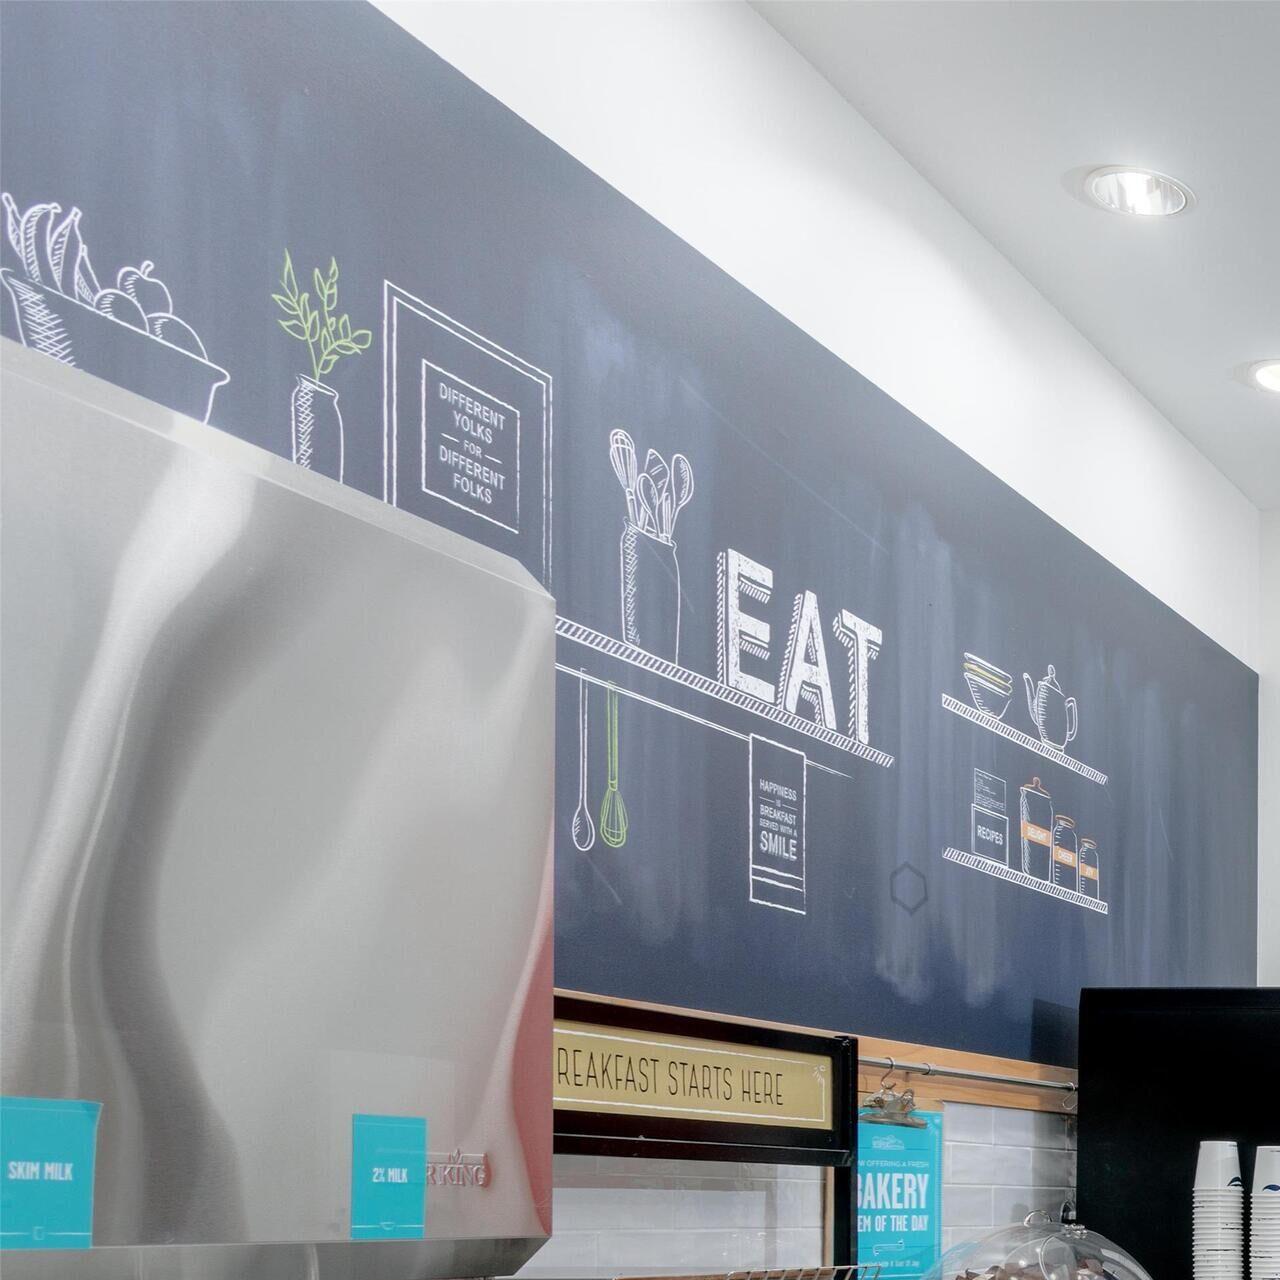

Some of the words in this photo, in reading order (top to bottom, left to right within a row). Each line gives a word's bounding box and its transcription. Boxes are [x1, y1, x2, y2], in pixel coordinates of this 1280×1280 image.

[440, 382, 506, 431] DIFFERENT
[453, 410, 493, 444] YOLKS
[464, 440, 482, 458] FOR
[440, 445, 506, 490] DIFFERENT
[453, 473, 493, 504] FOLKS
[716, 547, 883, 745] EAT
[759, 778, 798, 801] HAPPINESS
[760, 804, 797, 826] BREAKFAST
[759, 831, 798, 861] SMILE
[977, 824, 1003, 845] RECIPES
[557, 1047, 659, 1094] REAKFAST
[668, 1061, 733, 1101] STARTS
[741, 1069, 784, 1106] HERE
[8, 1161, 39, 1180] SKIM
[44, 1162, 73, 1181] MILK
[372, 1167, 385, 1182] 2%
[387, 1168, 408, 1183] MILK
[440, 1163, 484, 1186] KING
[857, 1215, 871, 1232] EM
[875, 1215, 887, 1232] OF
[890, 1215, 908, 1231] THE
[911, 1215, 929, 1231] DAY
